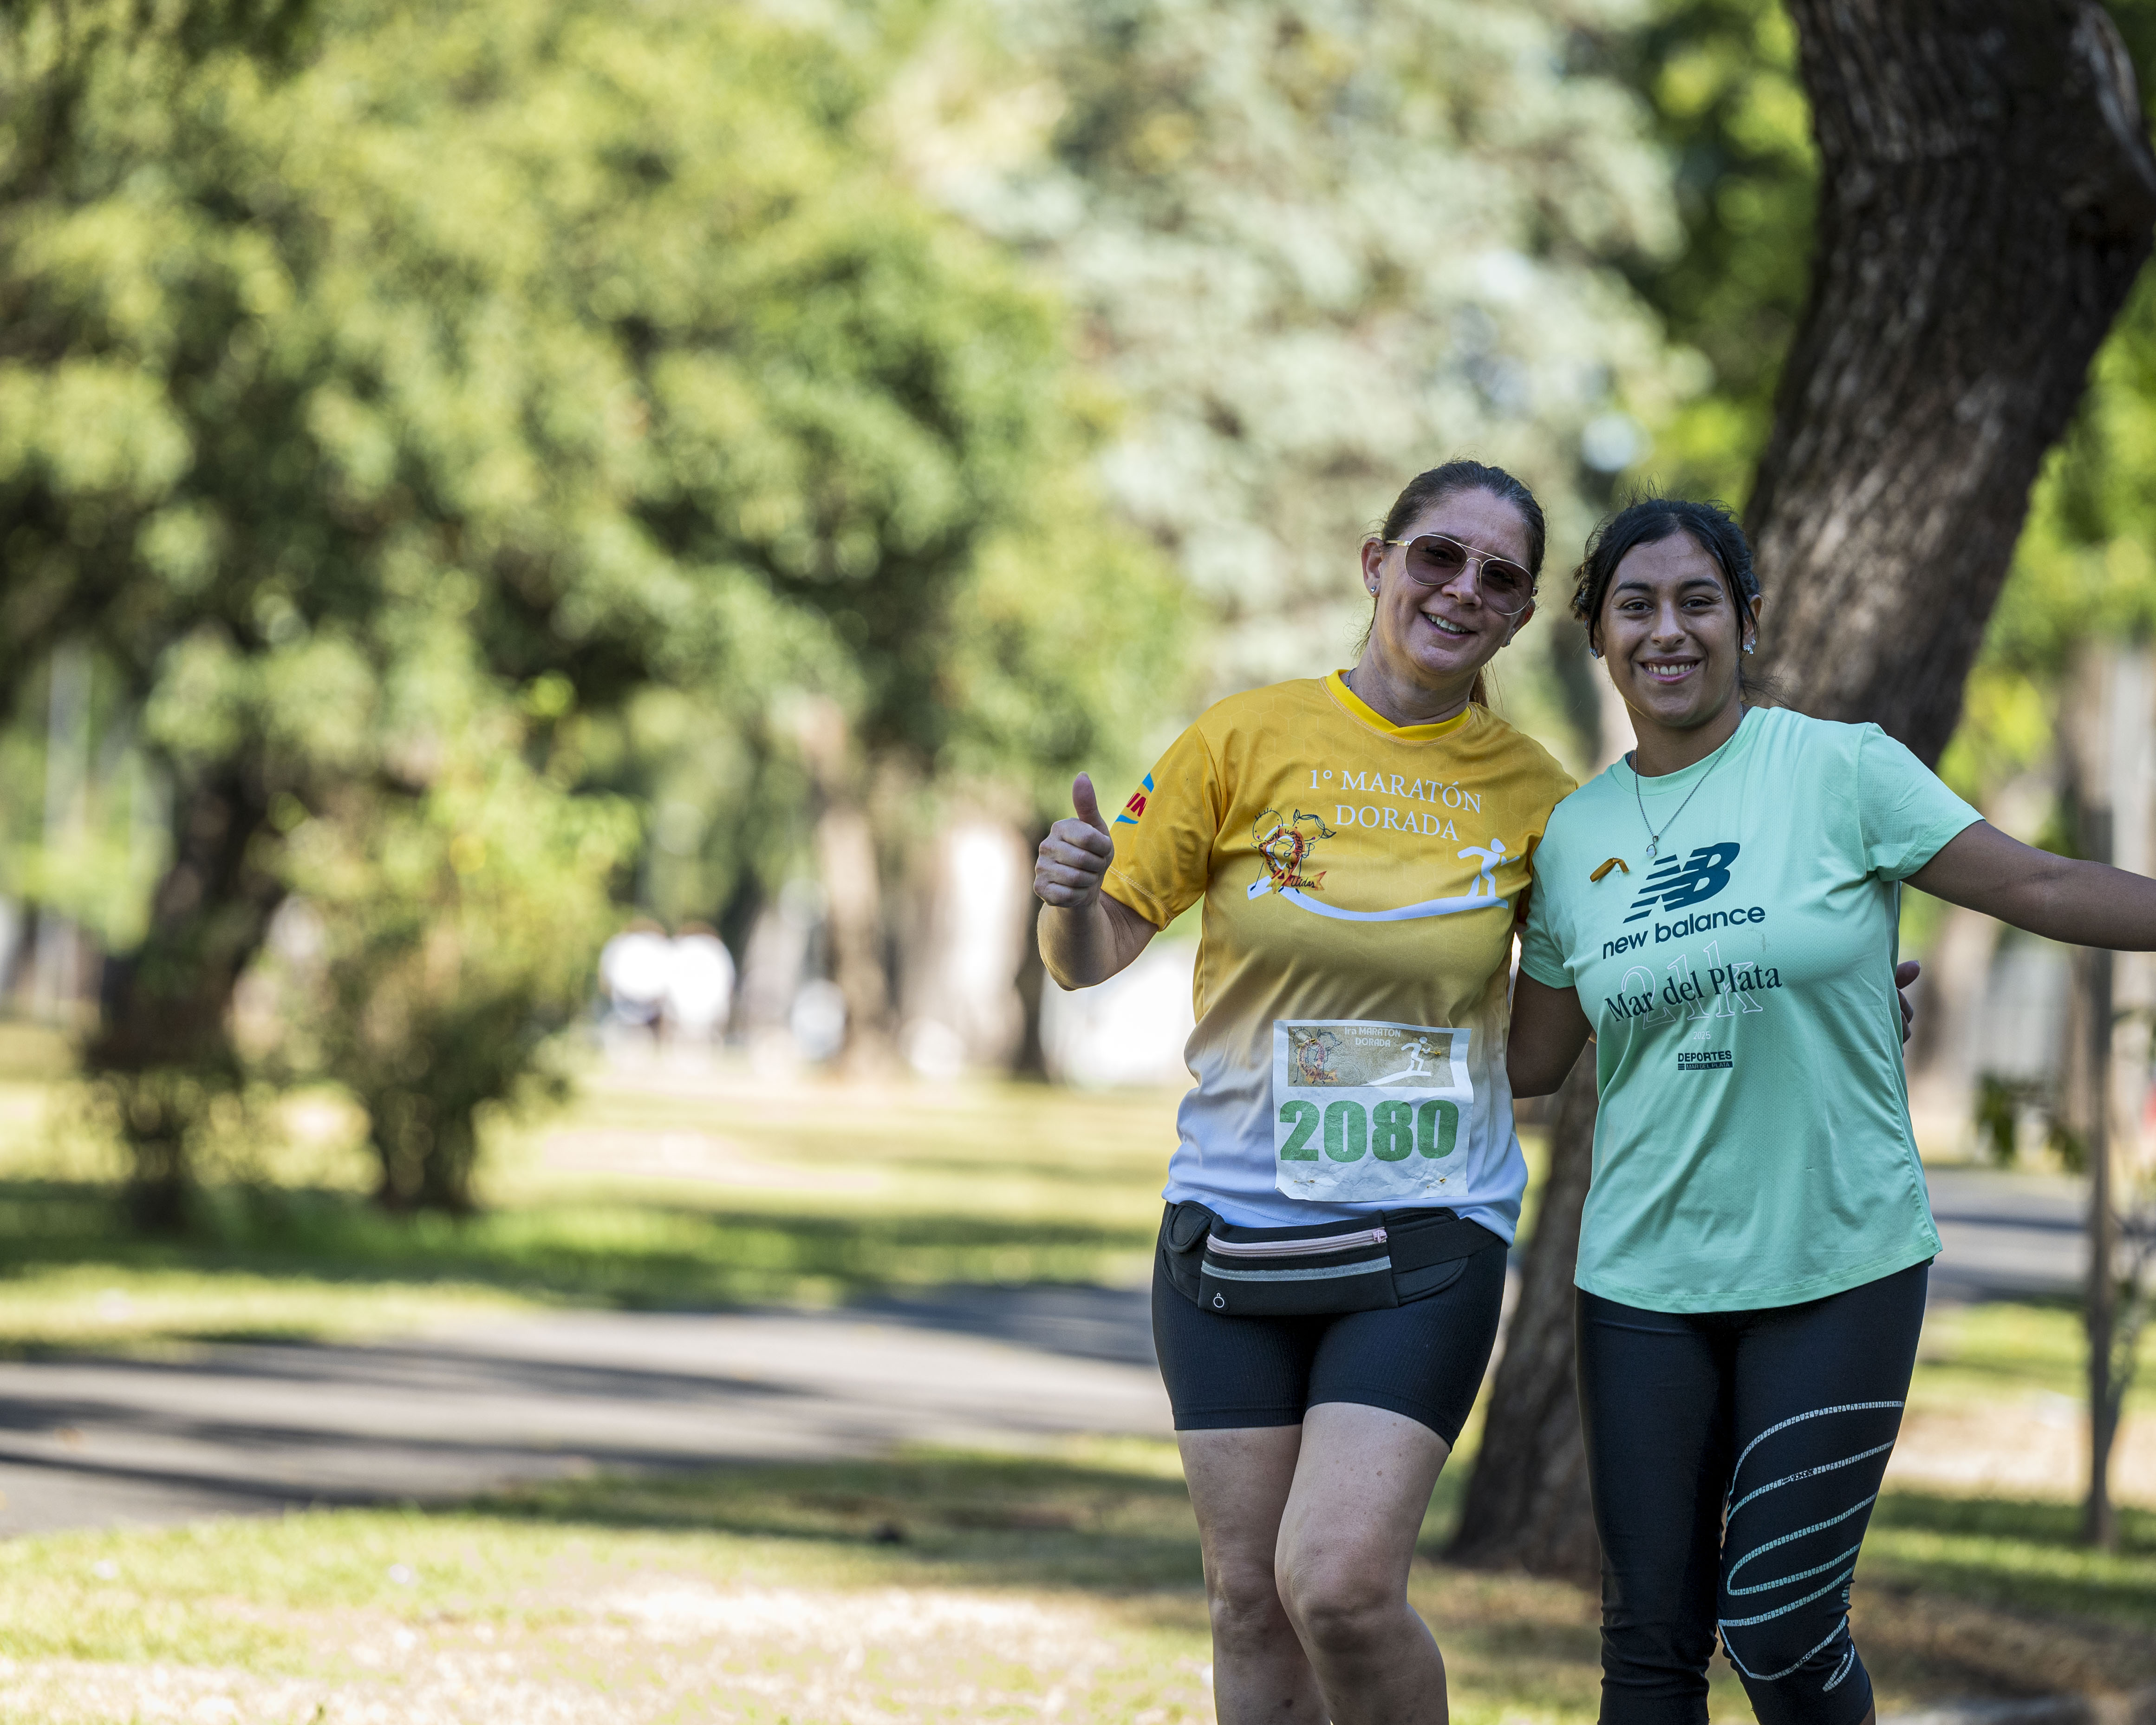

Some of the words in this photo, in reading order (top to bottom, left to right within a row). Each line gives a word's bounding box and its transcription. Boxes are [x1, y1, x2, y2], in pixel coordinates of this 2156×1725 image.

[1341, 771, 1481, 813] MARATÓN
[1335, 804, 1459, 842] DORADA
[1602, 930, 1648, 960] new
[1655, 906, 1766, 944] balance
[1604, 991, 1654, 1022] Mar
[1663, 971, 1703, 1006] del
[1709, 963, 1782, 995] Plata
[1355, 1037, 1391, 1047] DORADA
[1693, 1031, 1711, 1040] 2025
[1678, 1050, 1732, 1062] DEPORTES
[1279, 1099, 1459, 1163] 2080
